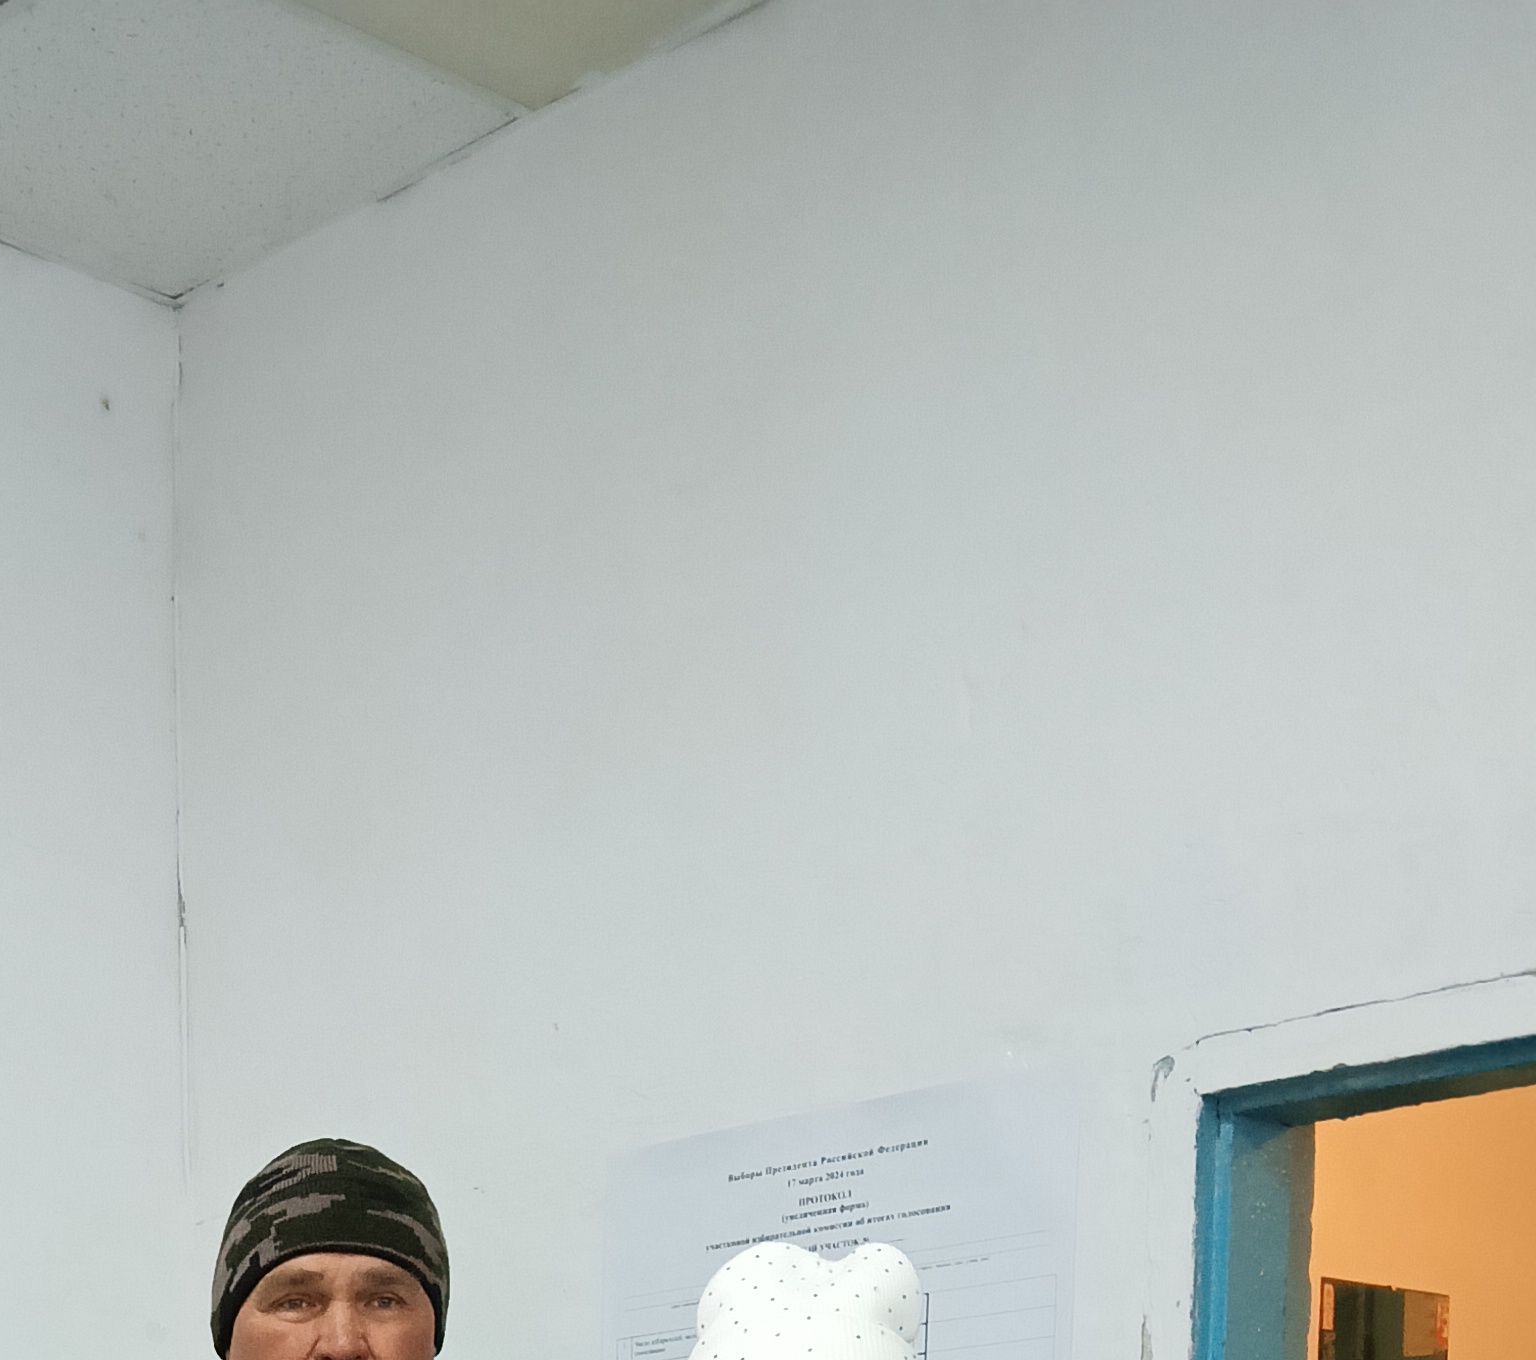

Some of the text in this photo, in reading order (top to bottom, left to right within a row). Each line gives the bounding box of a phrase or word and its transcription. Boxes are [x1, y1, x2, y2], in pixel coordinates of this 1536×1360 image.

[728, 1171, 763, 1182] Выборы
[821, 1148, 874, 1164] Российской
[878, 1139, 928, 1154] Федерации
[787, 1178, 796, 1188] 17
[798, 1176, 823, 1186] марта
[799, 1189, 852, 1207] ПРОТОКОЛ
